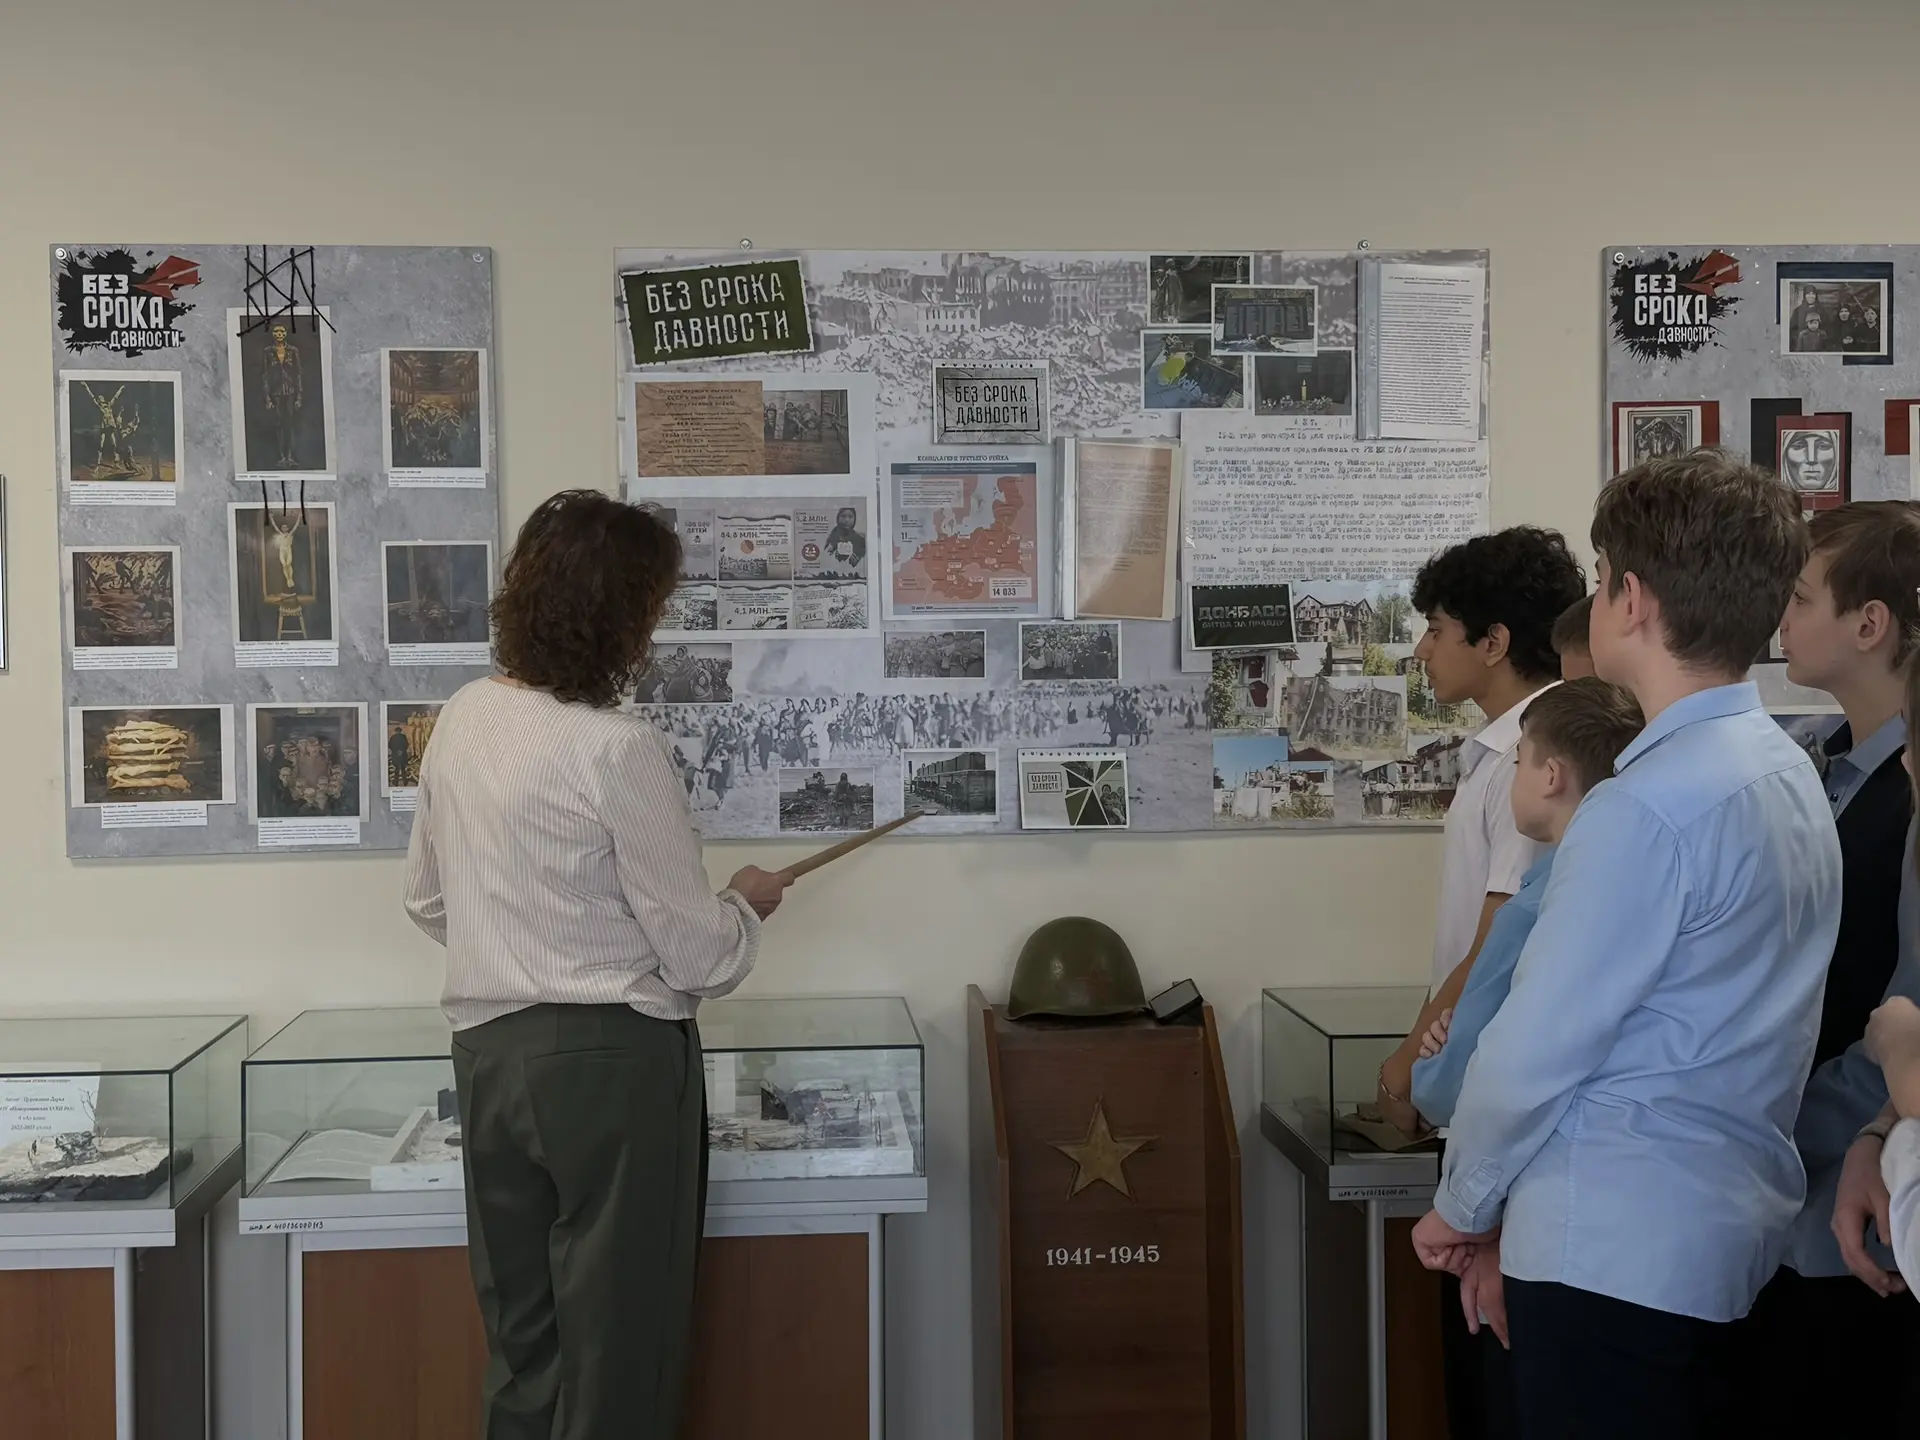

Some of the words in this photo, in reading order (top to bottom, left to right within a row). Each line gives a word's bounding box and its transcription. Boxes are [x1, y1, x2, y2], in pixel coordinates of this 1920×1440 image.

[82, 274, 129, 294] БЕЗ
[645, 280, 692, 313] БЕЗ
[700, 272, 785, 308] СРОКА
[1634, 274, 1676, 294] БЕЗ
[83, 296, 164, 329] СРОКА
[1634, 295, 1708, 326] СРОКА
[654, 309, 790, 355] ДАВНОСТИ
[955, 385, 978, 403] БЕЗ
[983, 385, 1027, 403] СРОКА
[956, 405, 1028, 426] ДАВНОСТИ
[739, 531, 760, 539] МЛН.
[993, 588, 1000, 596] 14
[748, 607, 770, 615] МЛН.
[1198, 604, 1288, 621] ДОНБАСС
[1248, 619, 1285, 627] ПРАВДУ
[1046, 1244, 1161, 1266] 1941-1945
